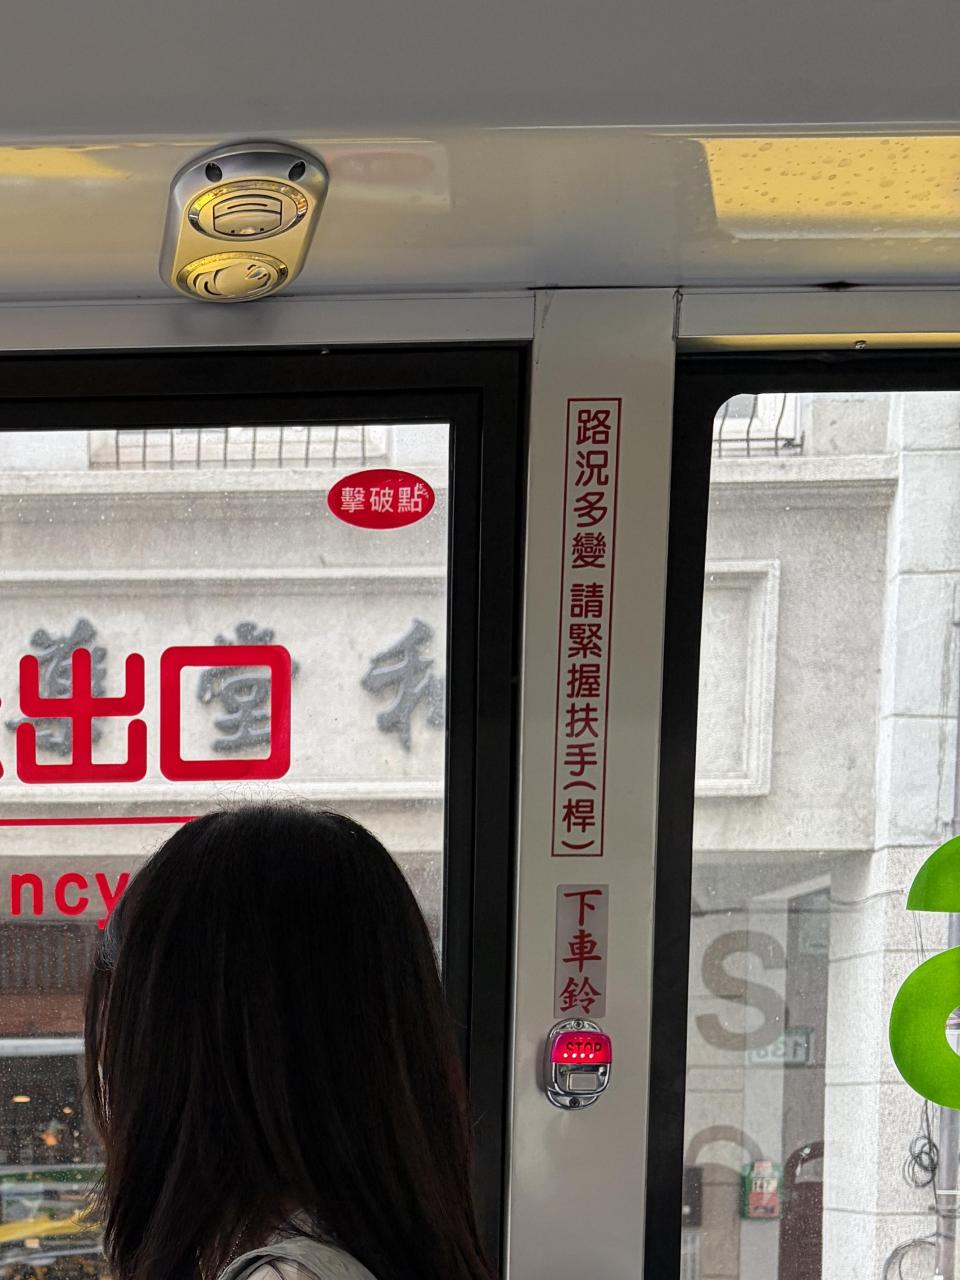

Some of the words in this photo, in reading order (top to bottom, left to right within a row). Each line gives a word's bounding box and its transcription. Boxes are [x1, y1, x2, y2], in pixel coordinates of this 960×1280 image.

[340, 485, 424, 513] 擊破點
[571, 408, 612, 570] 路況多變
[559, 889, 603, 1015] 下車鈴
[566, 1041, 602, 1052] STOP
